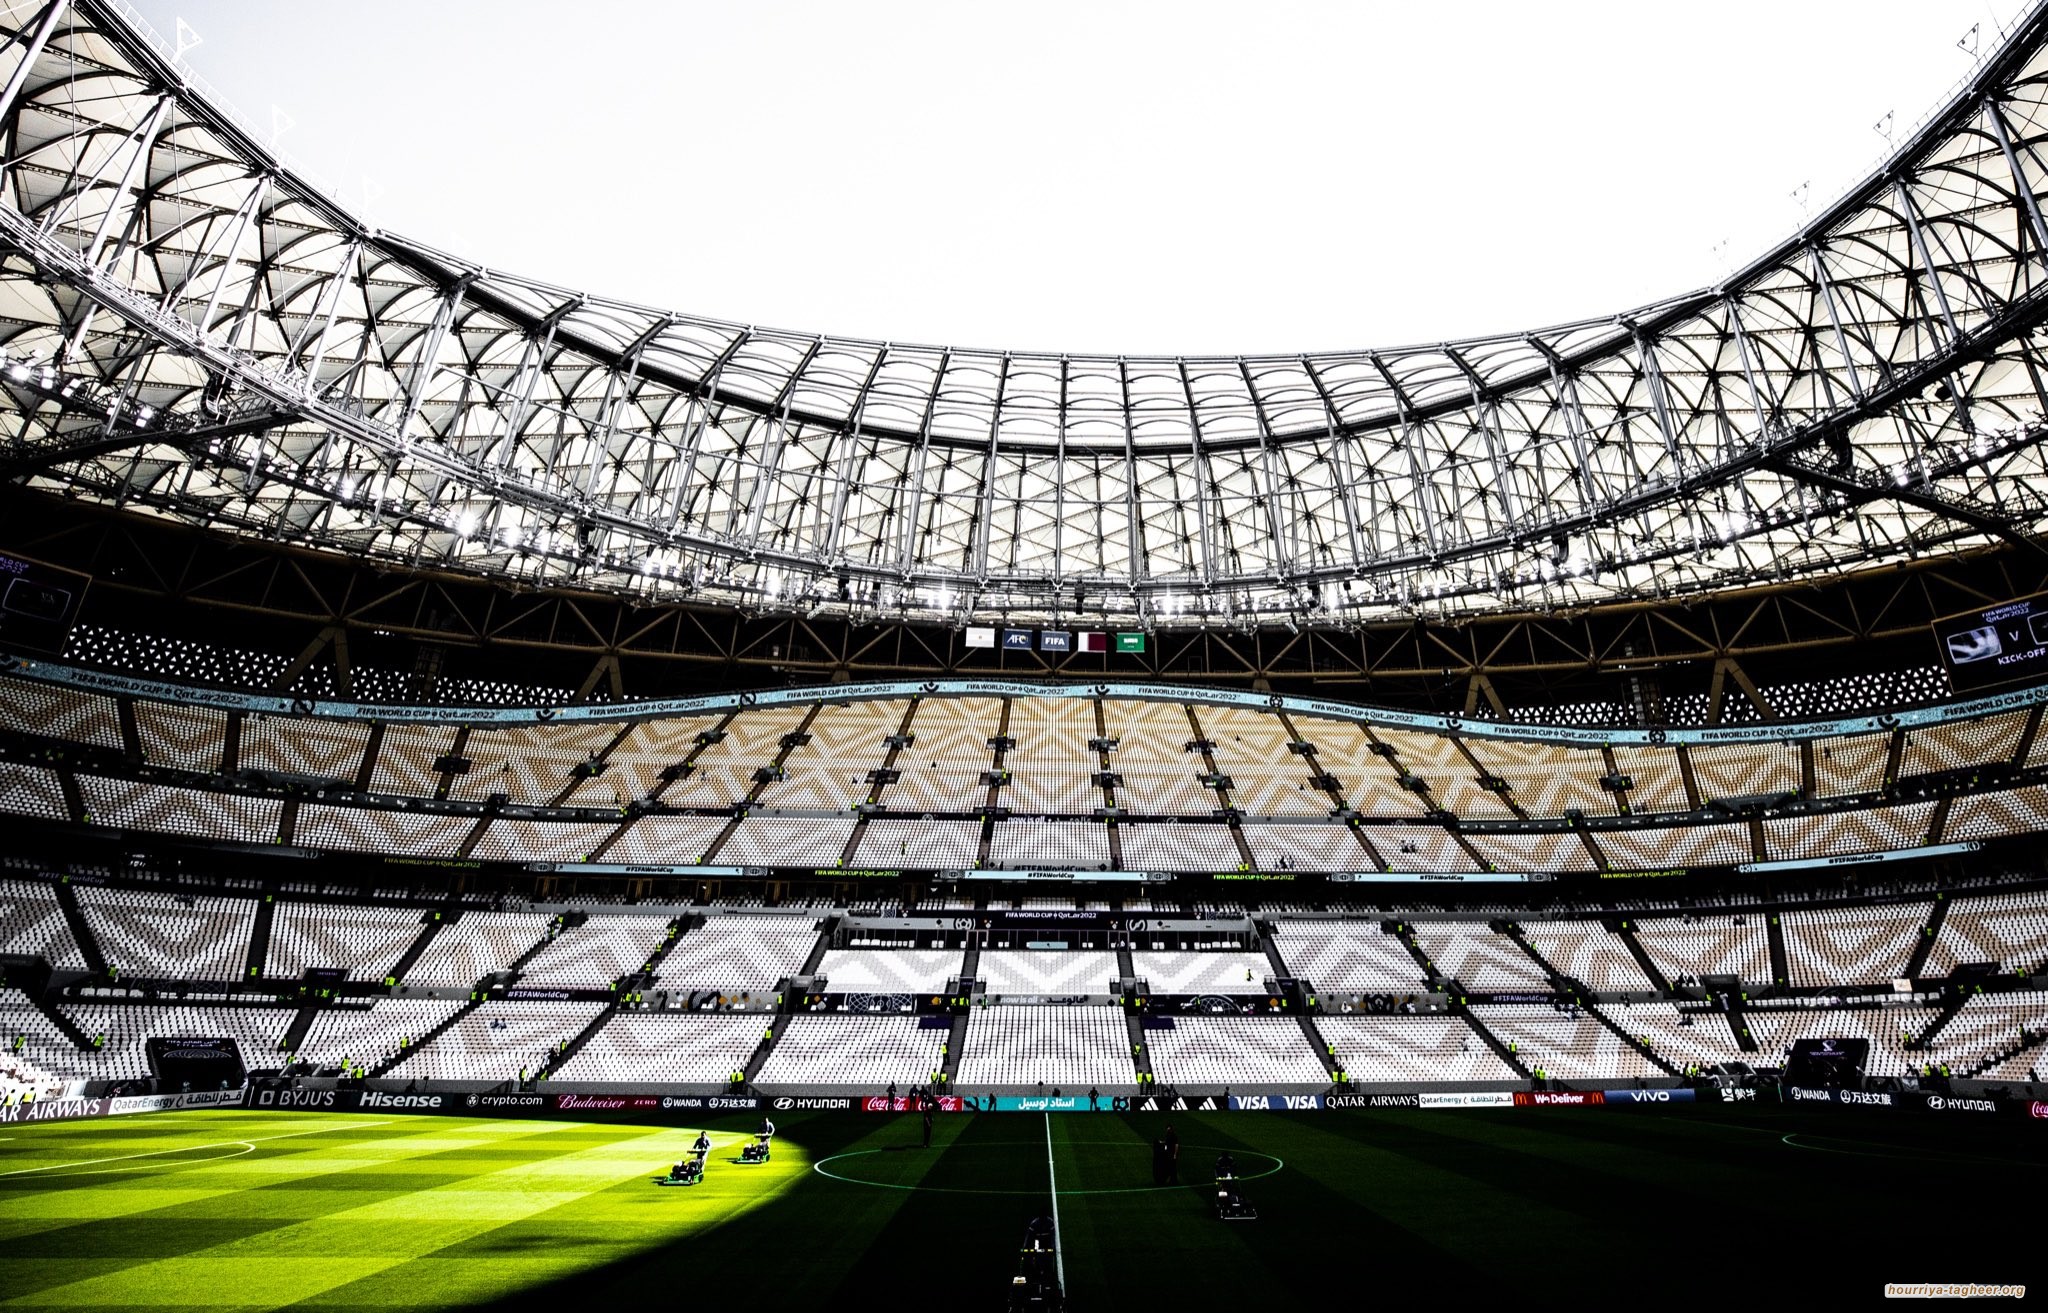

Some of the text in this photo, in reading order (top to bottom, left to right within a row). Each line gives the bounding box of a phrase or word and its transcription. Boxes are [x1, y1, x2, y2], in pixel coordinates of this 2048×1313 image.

[1007, 635, 1027, 644] AFC
[2009, 630, 2018, 641] V
[1045, 637, 1065, 646] FIFA
[1998, 647, 2046, 665] KICK-OFF
[71, 673, 98, 682] FIFA
[98, 677, 138, 690] WORLD
[142, 683, 163, 694] CUP
[1327, 705, 1350, 713] WORLD
[1944, 695, 2025, 716] FIFA WORLD CUP
[378, 708, 411, 716] WORLD
[1511, 728, 1537, 736] WORLD
[1720, 730, 1750, 738] WORLD
[1752, 729, 1768, 737] CUP
[1829, 854, 1883, 863] #FIFAWorldCup
[508, 991, 569, 1000] #FIFAWorldCup
[1019, 996, 1027, 1004] is
[1027, 996, 1038, 1004] all
[1493, 995, 1548, 1003] #FIFAWorldCup
[279, 1091, 335, 1106] BYJU'S
[360, 1092, 442, 1108] Hisense
[1534, 1093, 1584, 1104] We Deliver
[1632, 1090, 1669, 1102] vivo
[1801, 1089, 1831, 1100] WANDA
[114, 1097, 174, 1110] QatarEnergy
[481, 1096, 543, 1107] crypto.com
[559, 1094, 626, 1108] Budweiser
[674, 1099, 702, 1107] WANDA
[797, 1099, 850, 1109] HYUNDAI
[1018, 1098, 1074, 1109] استاد لوسيل
[1235, 1096, 1270, 1109] VISA
[1283, 1096, 1318, 1109] VISA
[1326, 1096, 1417, 1108] QATAR AIRWAYS
[1421, 1096, 1461, 1105] QatarEnergy
[1947, 1098, 1996, 1112] HYUNDAI
[26, 1099, 101, 1120] AIRWAYS
